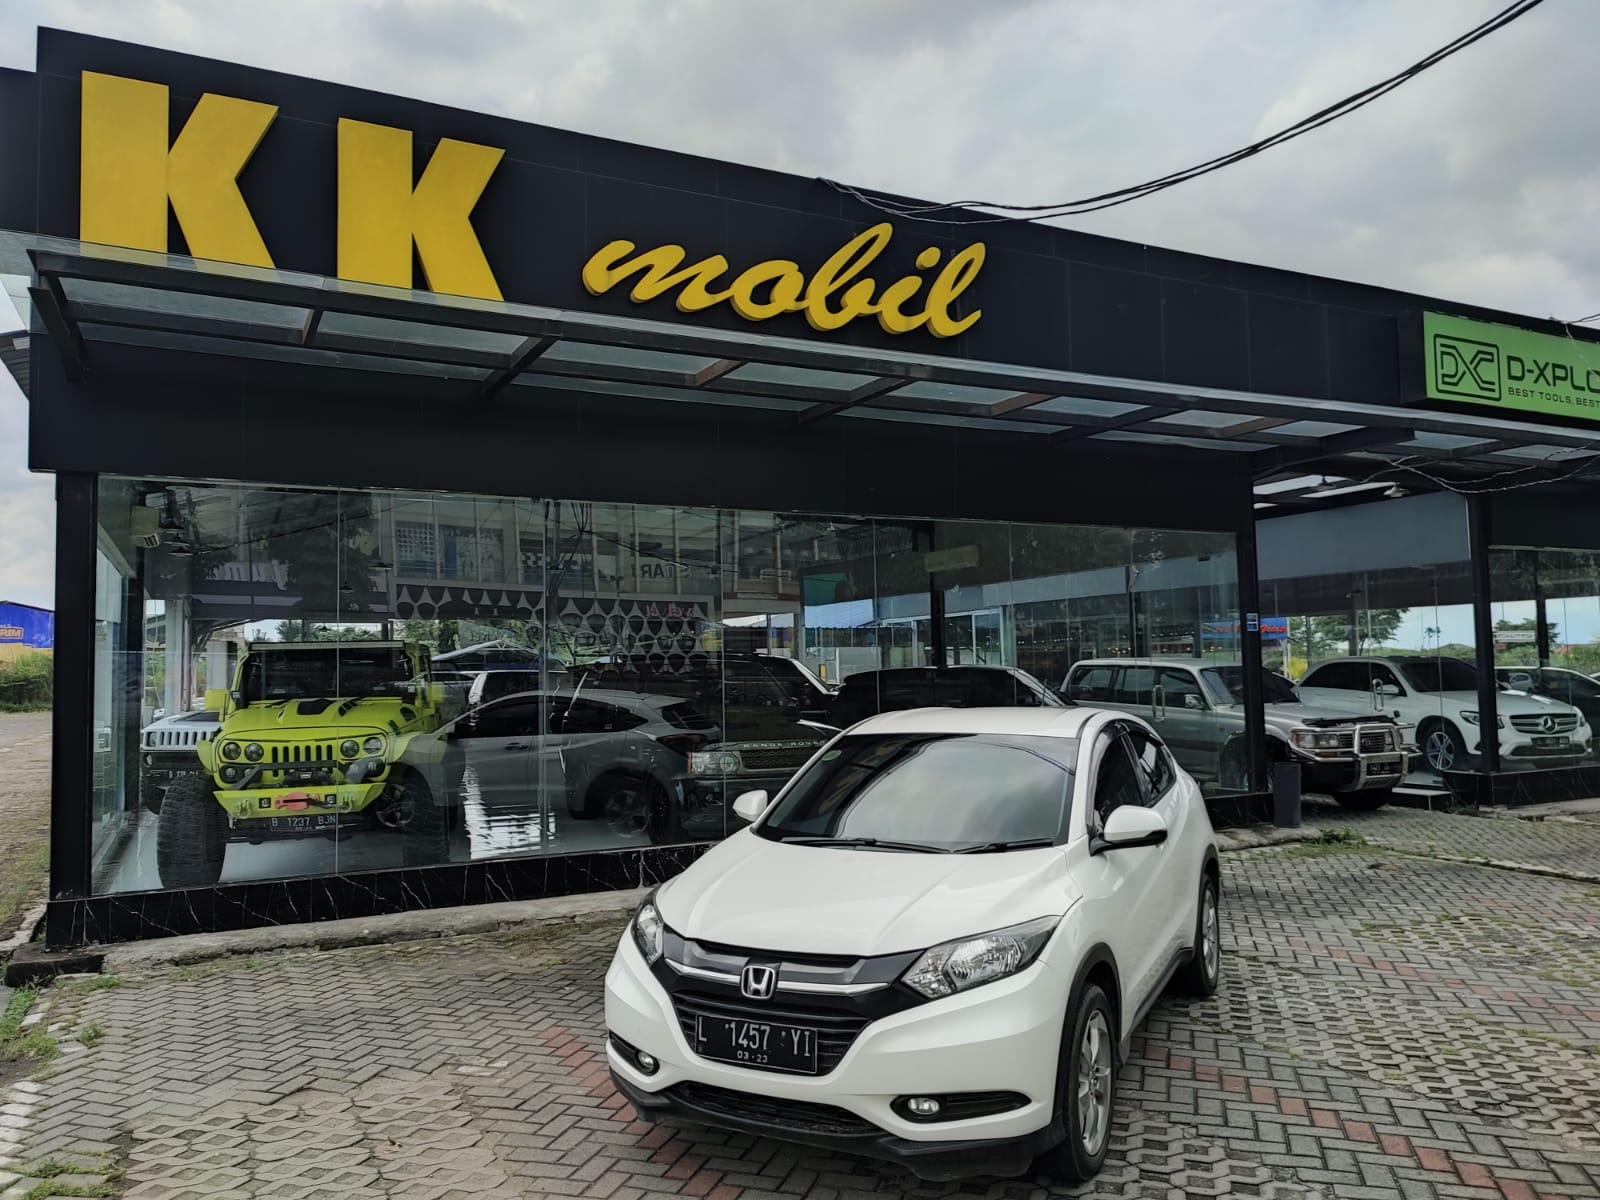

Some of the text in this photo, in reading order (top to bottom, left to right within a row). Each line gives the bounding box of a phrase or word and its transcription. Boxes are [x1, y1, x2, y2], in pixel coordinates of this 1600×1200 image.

[582, 222, 987, 338] mobil
[1508, 386, 1536, 399] BEST
[287, 816, 310, 827] 1237
[698, 1016, 811, 1057] L 1457 YI
